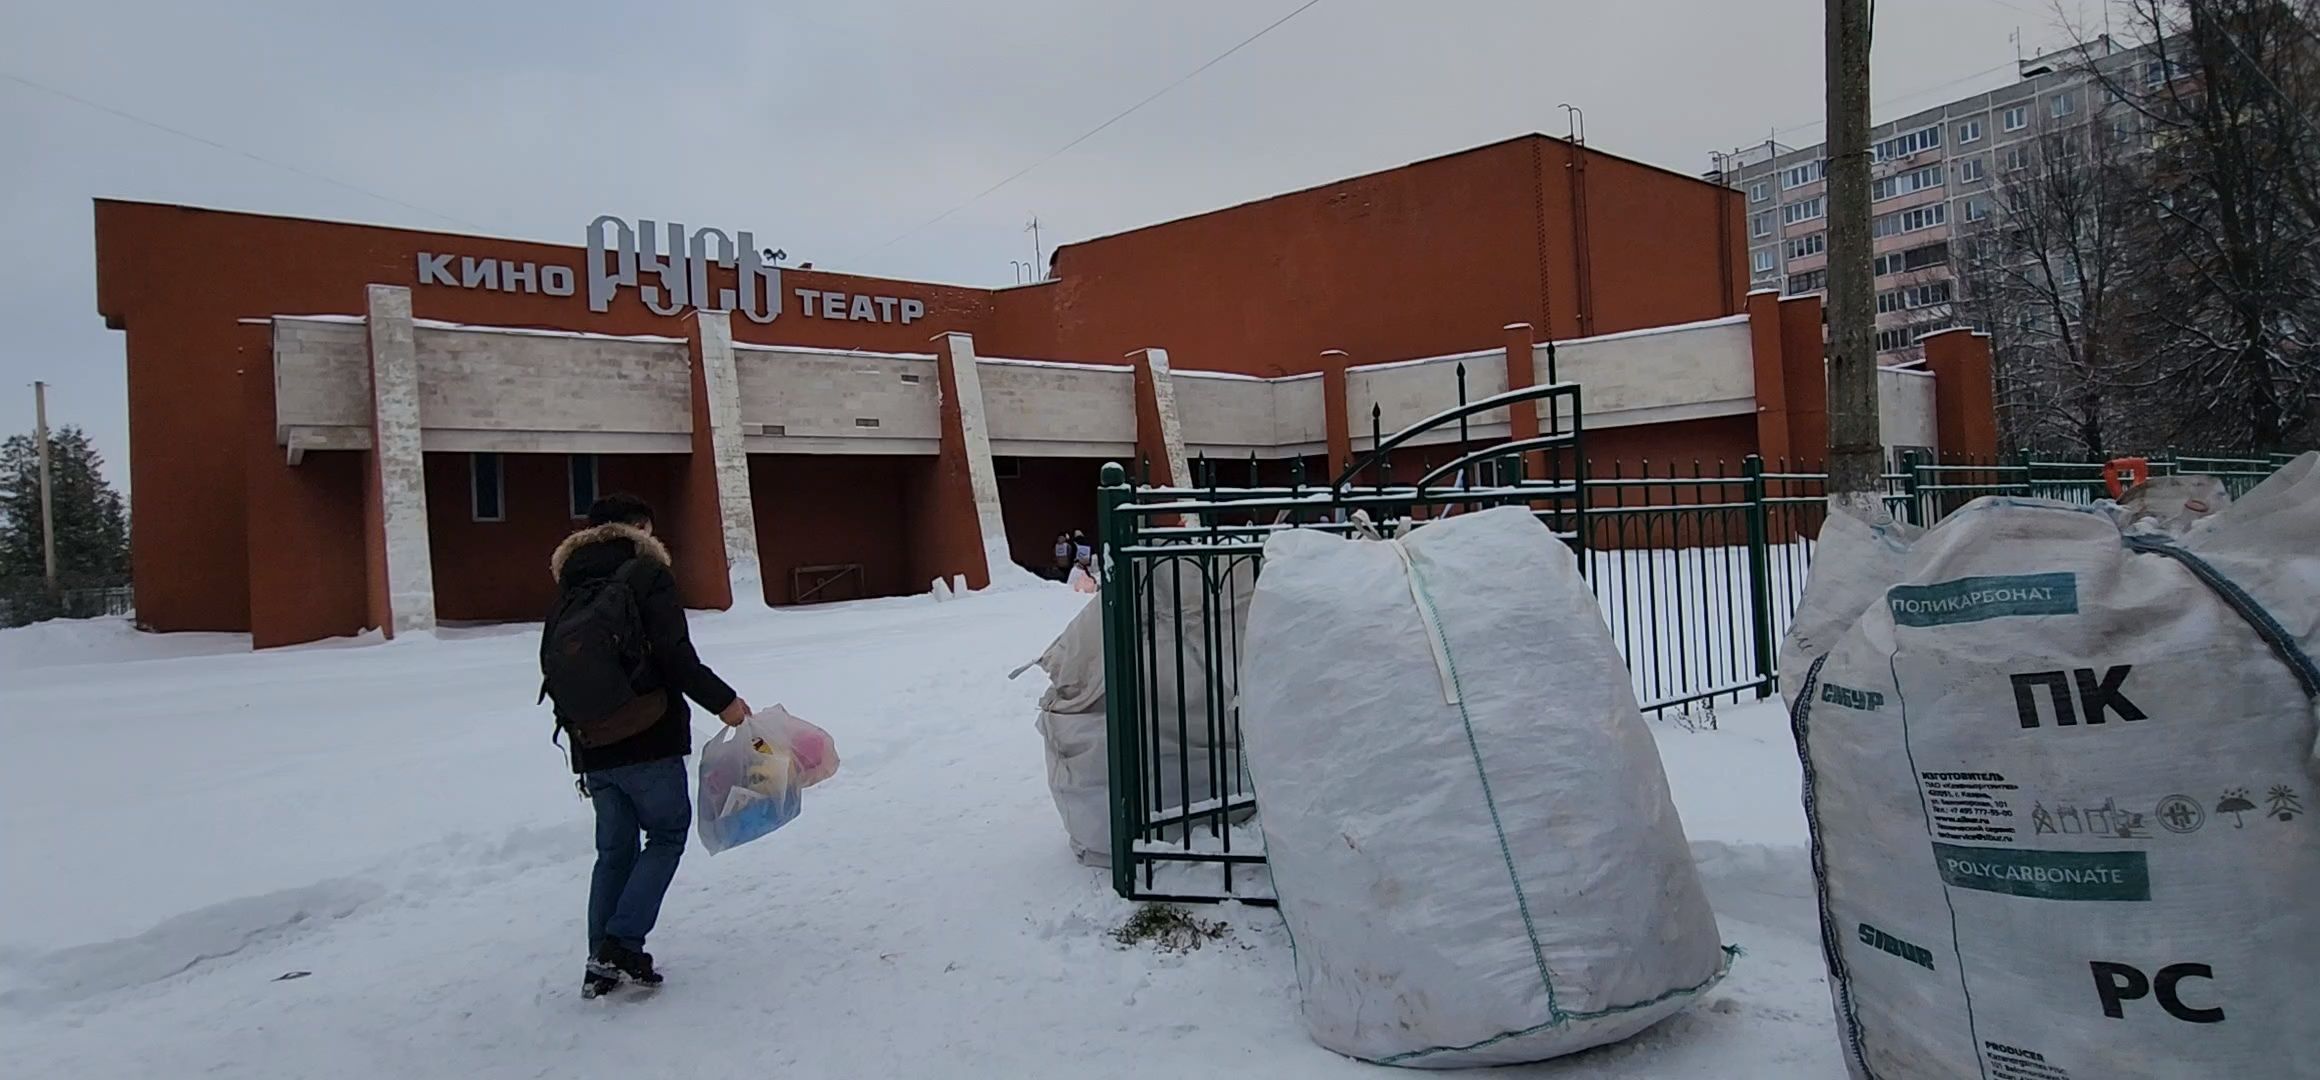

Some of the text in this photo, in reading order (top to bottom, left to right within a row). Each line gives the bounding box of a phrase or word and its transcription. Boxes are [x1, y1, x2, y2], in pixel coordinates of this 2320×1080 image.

[416, 215, 926, 325] КИНО РУСЬ ТЕАТР
[1891, 586, 2055, 615] ПОЛИКАРБОНАТ
[2009, 664, 2149, 729] ПК
[1921, 772, 2005, 781] ИЗГОТОВИТЕЛЬ
[1946, 858, 2124, 885] POLYCARBONATE
[1858, 922, 1935, 971] SIBUR
[2090, 960, 2226, 1023] PC
[1985, 1041, 2045, 1063] PRODUCER
